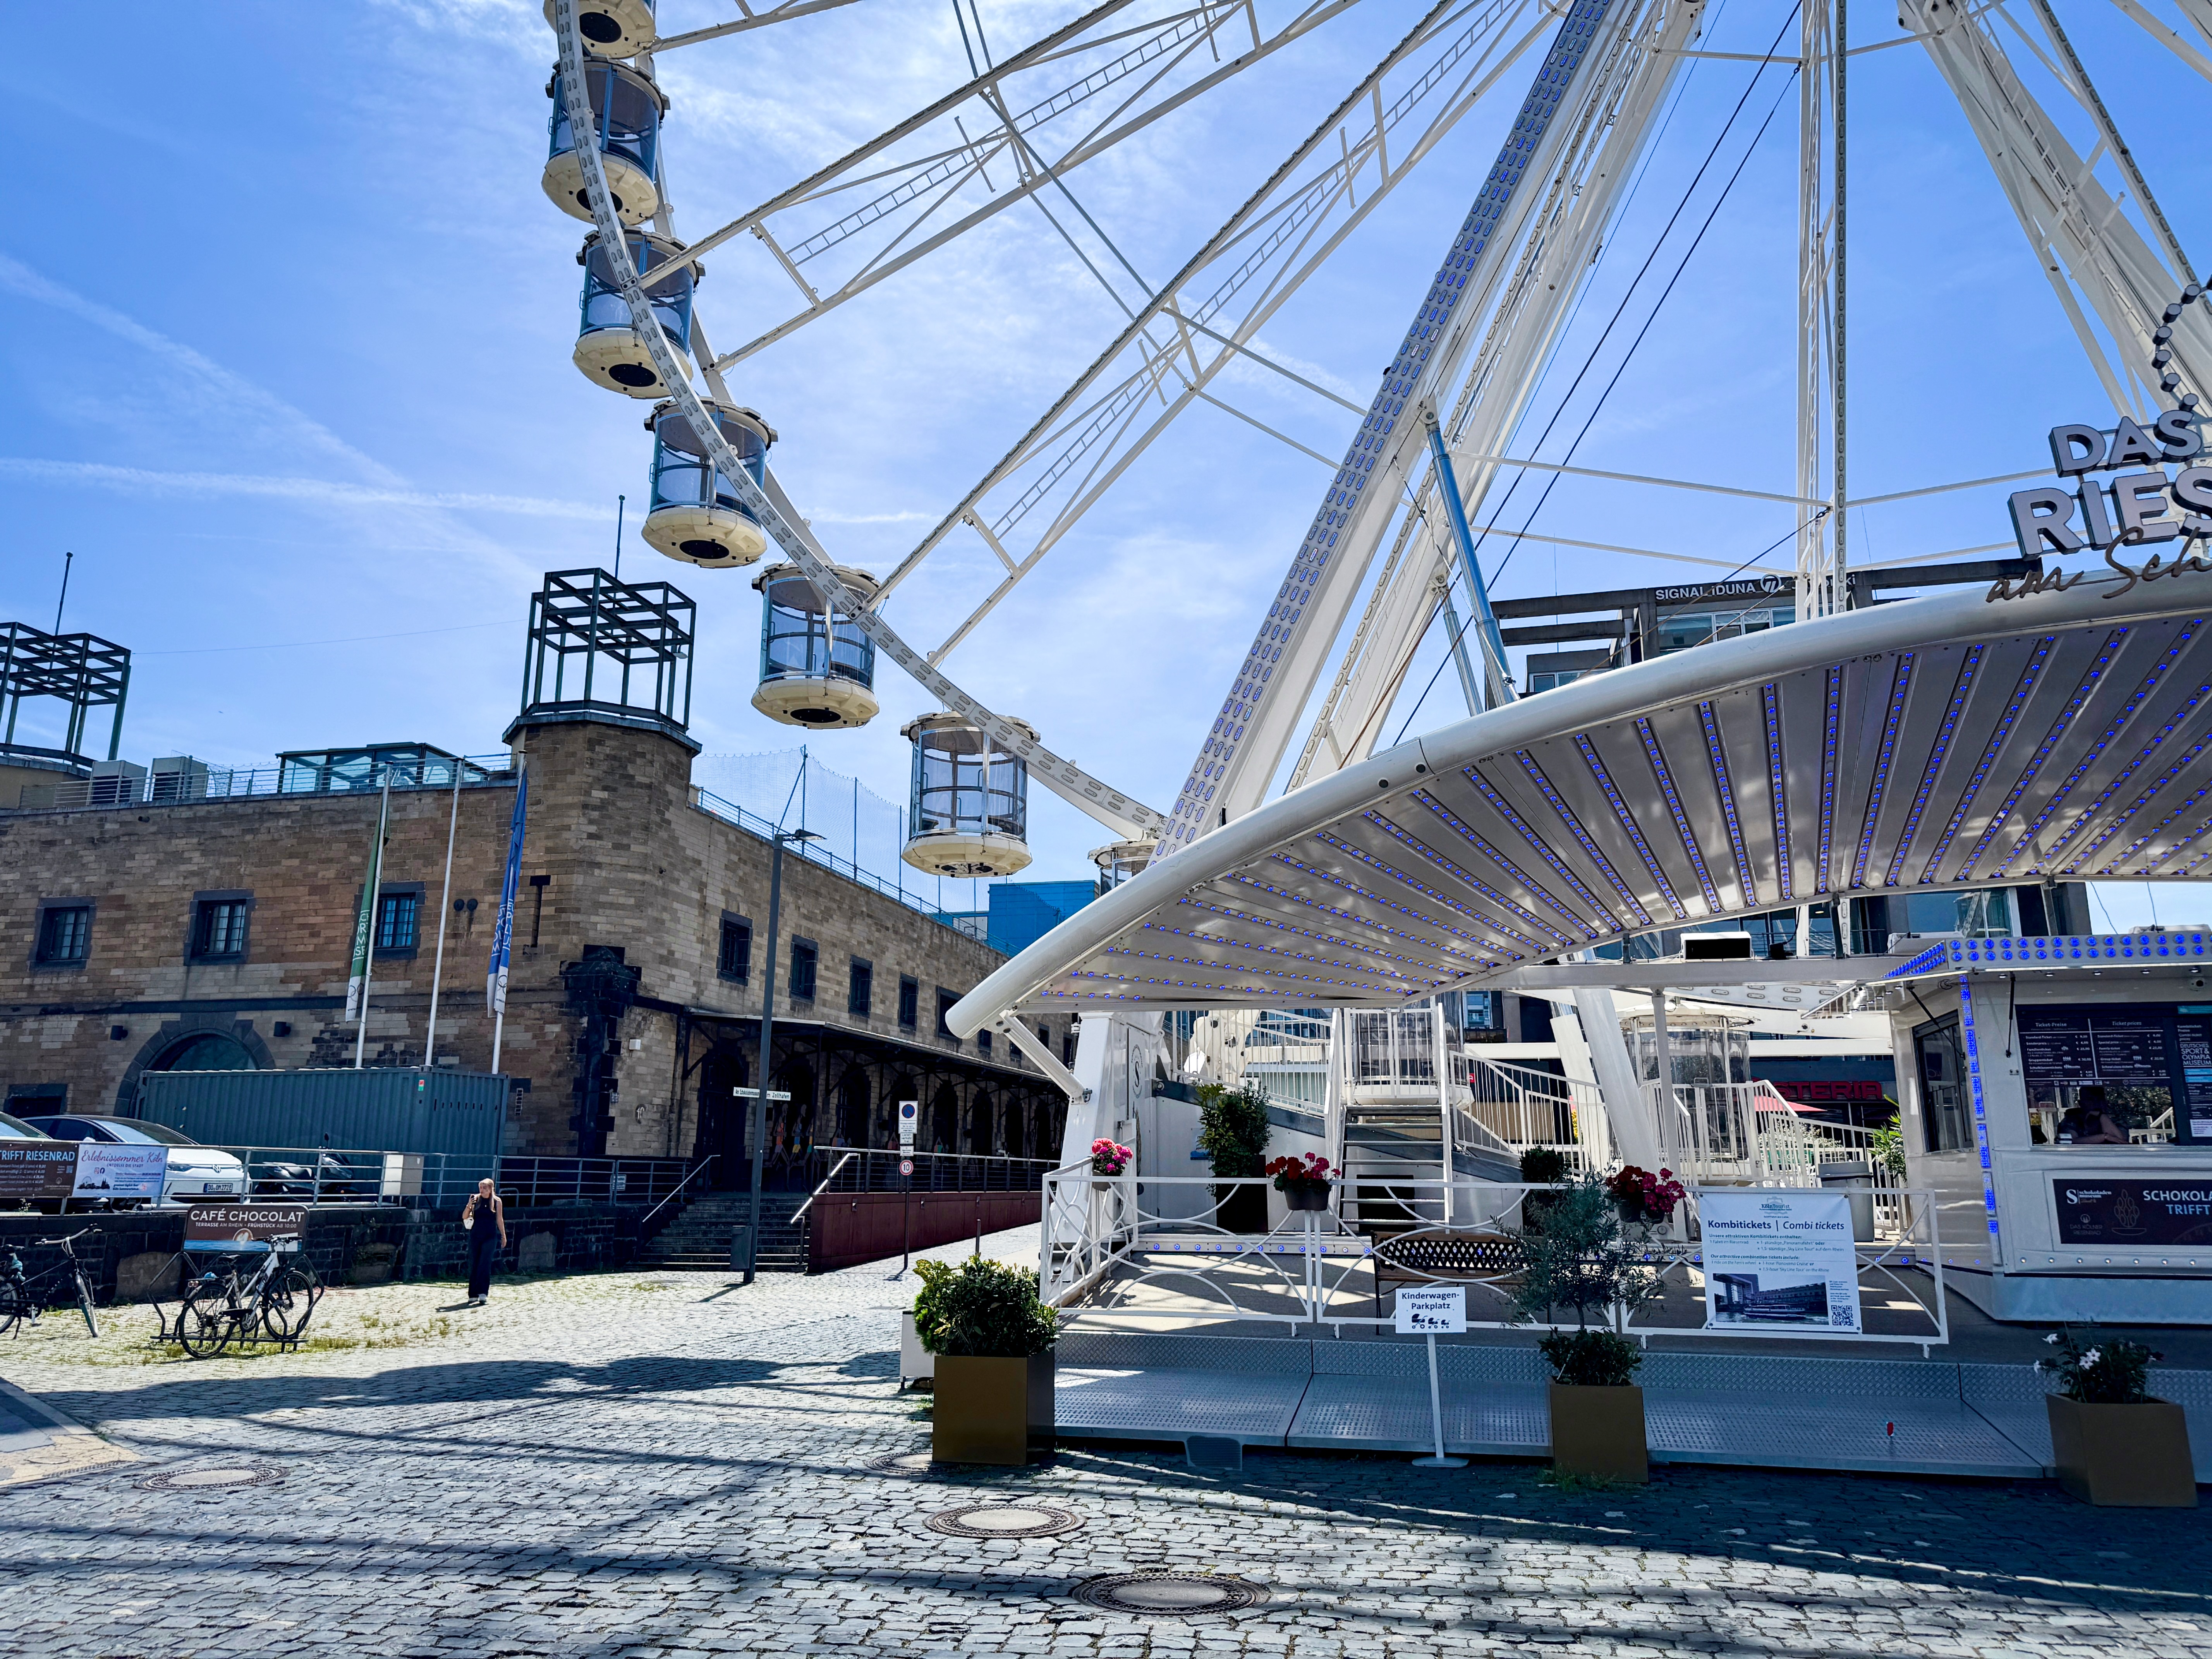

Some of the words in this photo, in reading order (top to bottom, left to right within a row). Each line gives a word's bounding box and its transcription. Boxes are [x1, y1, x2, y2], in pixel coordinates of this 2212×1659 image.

[2048, 410, 2203, 477] DAS
[2007, 467, 2212, 561] RIES
[1656, 586, 1708, 600] SIGNAL
[1712, 582, 1756, 596] IDUNA
[1985, 566, 2085, 603] am
[1773, 1080, 1882, 1099] STERIA
[26, 1151, 75, 1161] RIESENRAD
[81, 1150, 144, 1162] Erlebnissommer
[147, 1151, 163, 1163] Köln
[2066, 1189, 2078, 1204] S
[2143, 1190, 2212, 1201] SCHOKOLA
[191, 1208, 226, 1221] CAFÉ
[229, 1211, 304, 1222] CHOCOLAT
[2166, 1204, 2210, 1215] TRIFFT
[1708, 1220, 1771, 1229] Kombitickets
[1783, 1221, 1813, 1230] Combi
[1815, 1221, 1844, 1230] tickets
[1402, 1292, 1460, 1300] Kinderwagen-
[1412, 1302, 1450, 1311] Parkplatz
